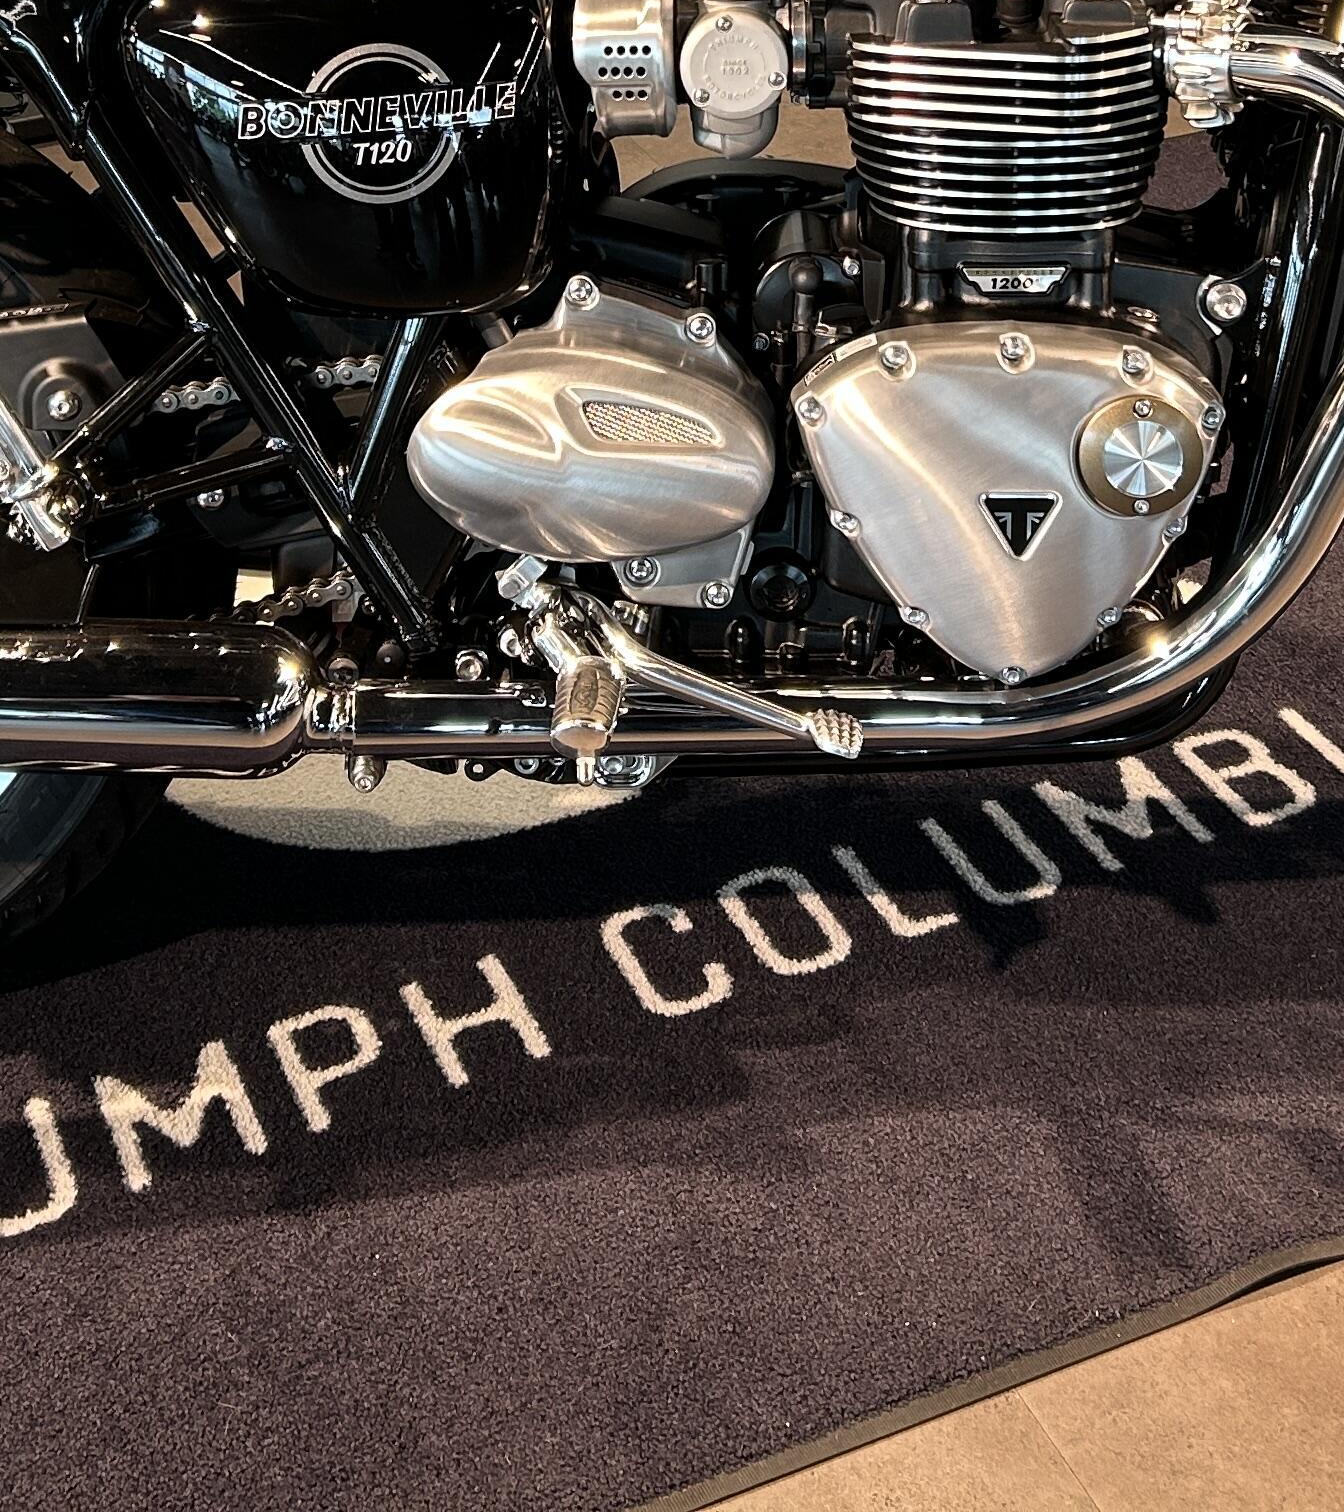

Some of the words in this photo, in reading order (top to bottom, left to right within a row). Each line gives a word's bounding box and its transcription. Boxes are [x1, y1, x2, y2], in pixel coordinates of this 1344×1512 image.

[238, 81, 516, 139] BONNEVILLE
[354, 139, 413, 166] T120
[991, 277, 1034, 290] 1200
